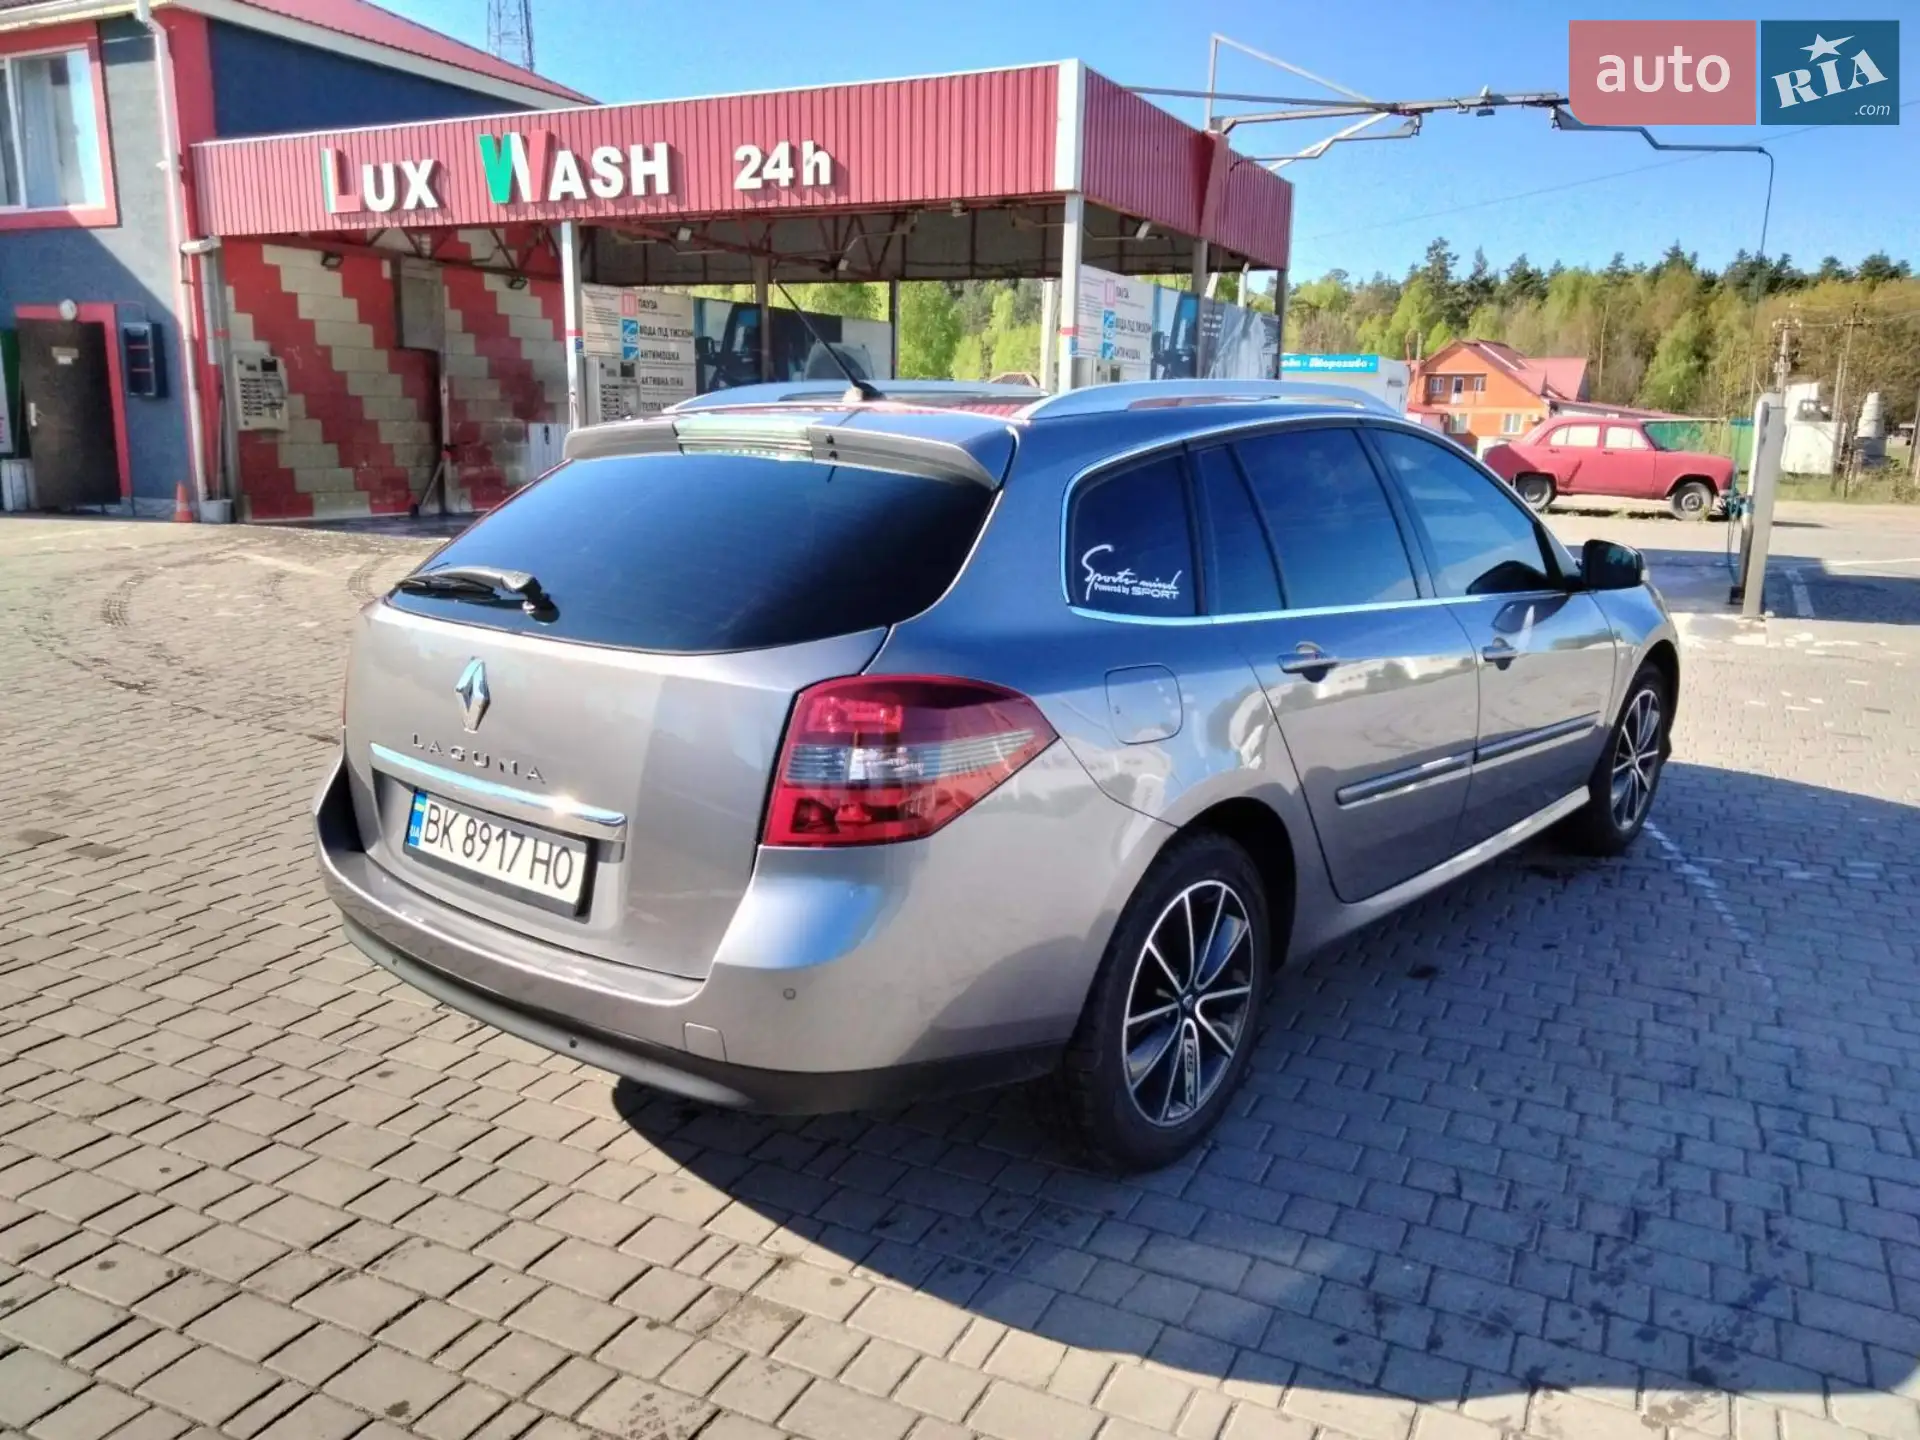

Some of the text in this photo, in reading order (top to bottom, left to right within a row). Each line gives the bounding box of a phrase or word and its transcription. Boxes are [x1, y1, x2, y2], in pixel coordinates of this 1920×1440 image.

[733, 140, 832, 190] 24h
[1131, 586, 1180, 599] SPORT
[413, 733, 546, 784] LAGUNA
[424, 803, 460, 853] BK
[462, 818, 526, 873] 8917
